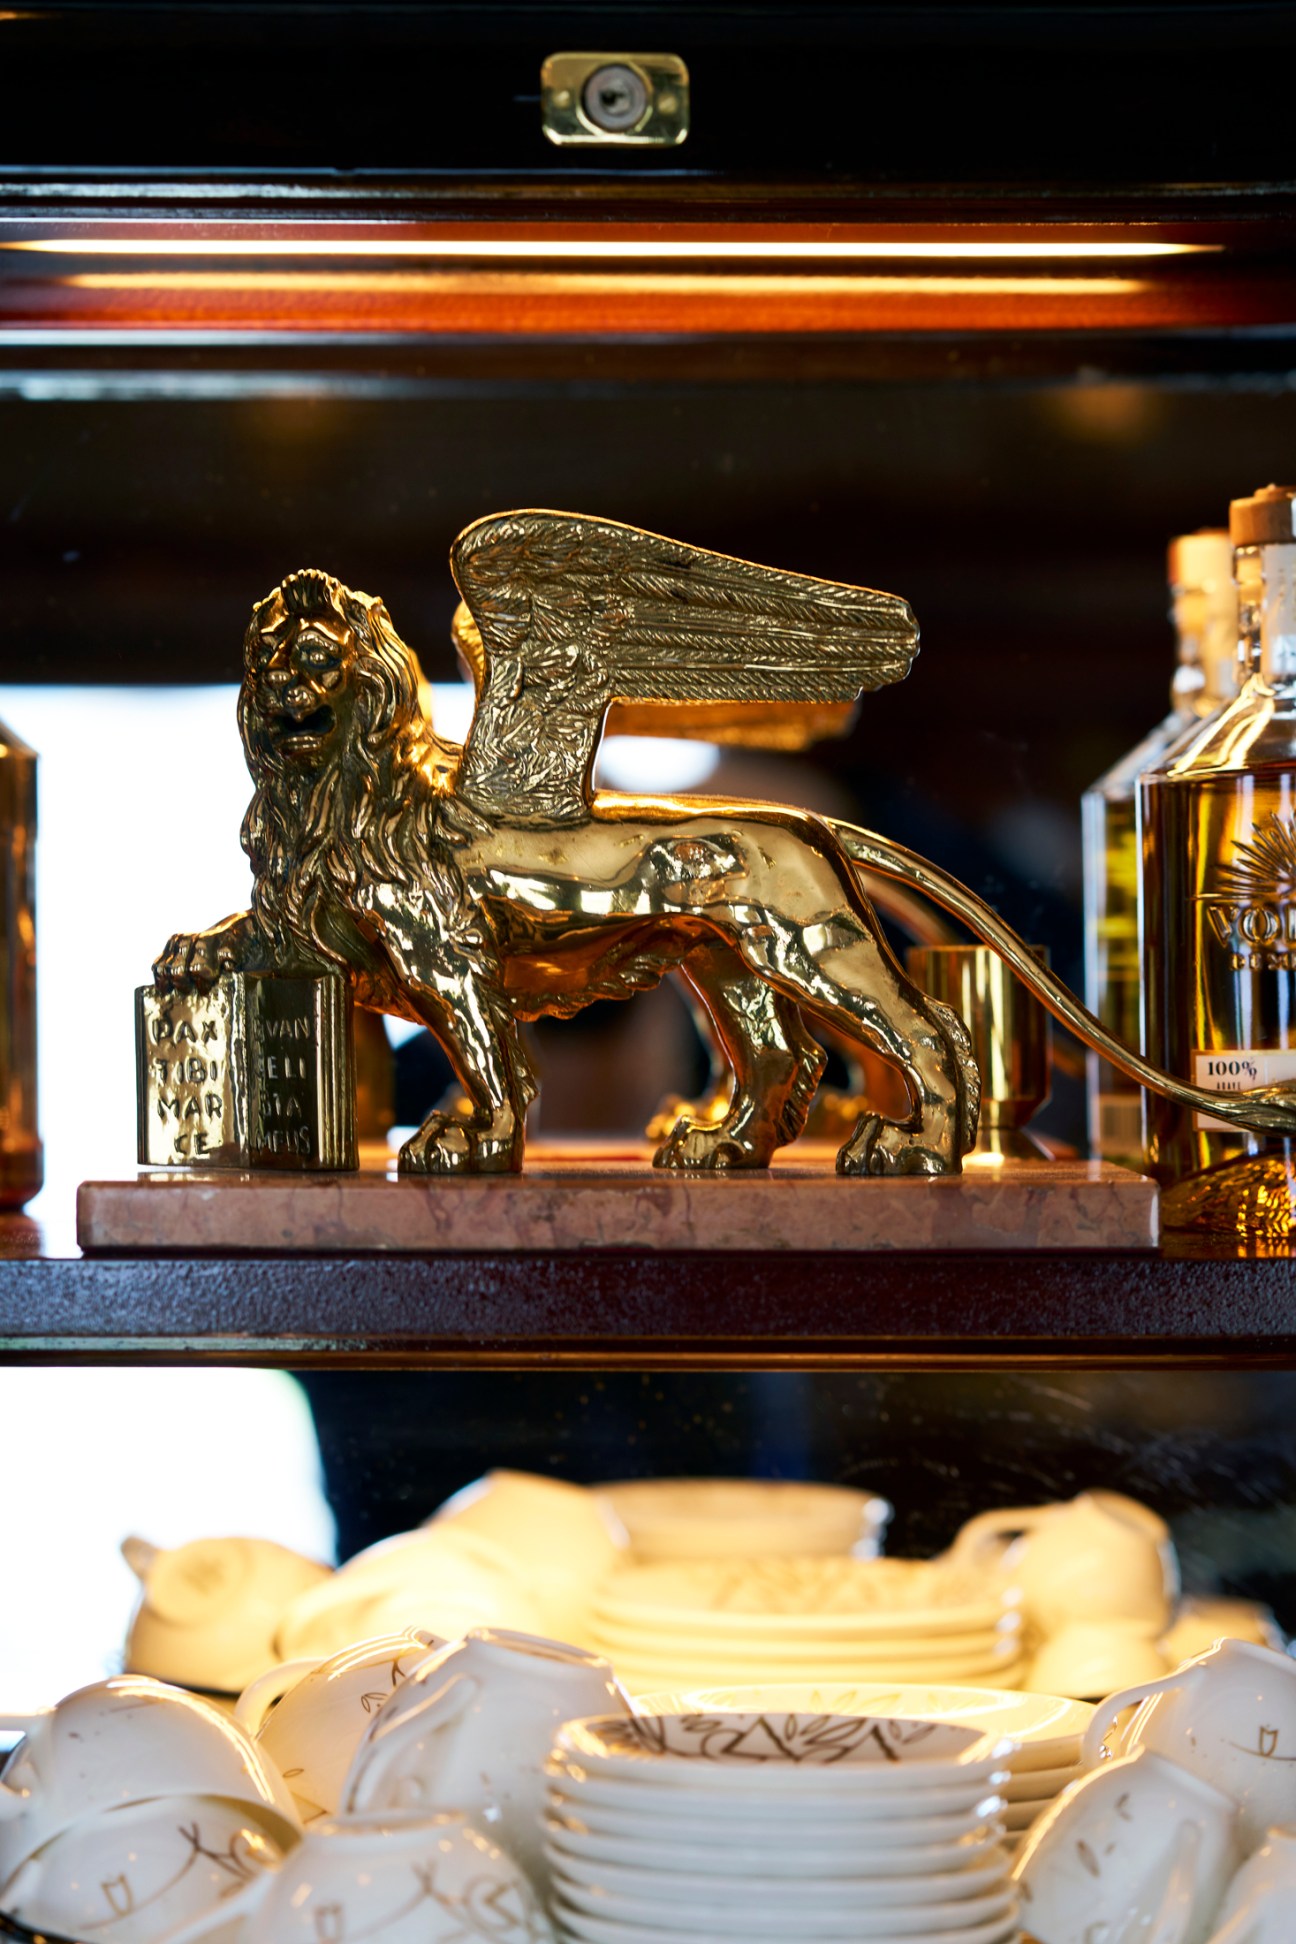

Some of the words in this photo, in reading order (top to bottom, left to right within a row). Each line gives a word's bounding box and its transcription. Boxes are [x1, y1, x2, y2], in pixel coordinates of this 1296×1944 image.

[151, 1017, 218, 1046] PAX
[153, 1057, 219, 1085] TIBI
[1208, 1058, 1258, 1080] 100%
[156, 1093, 223, 1119] MAR
[174, 1132, 210, 1155] CE
